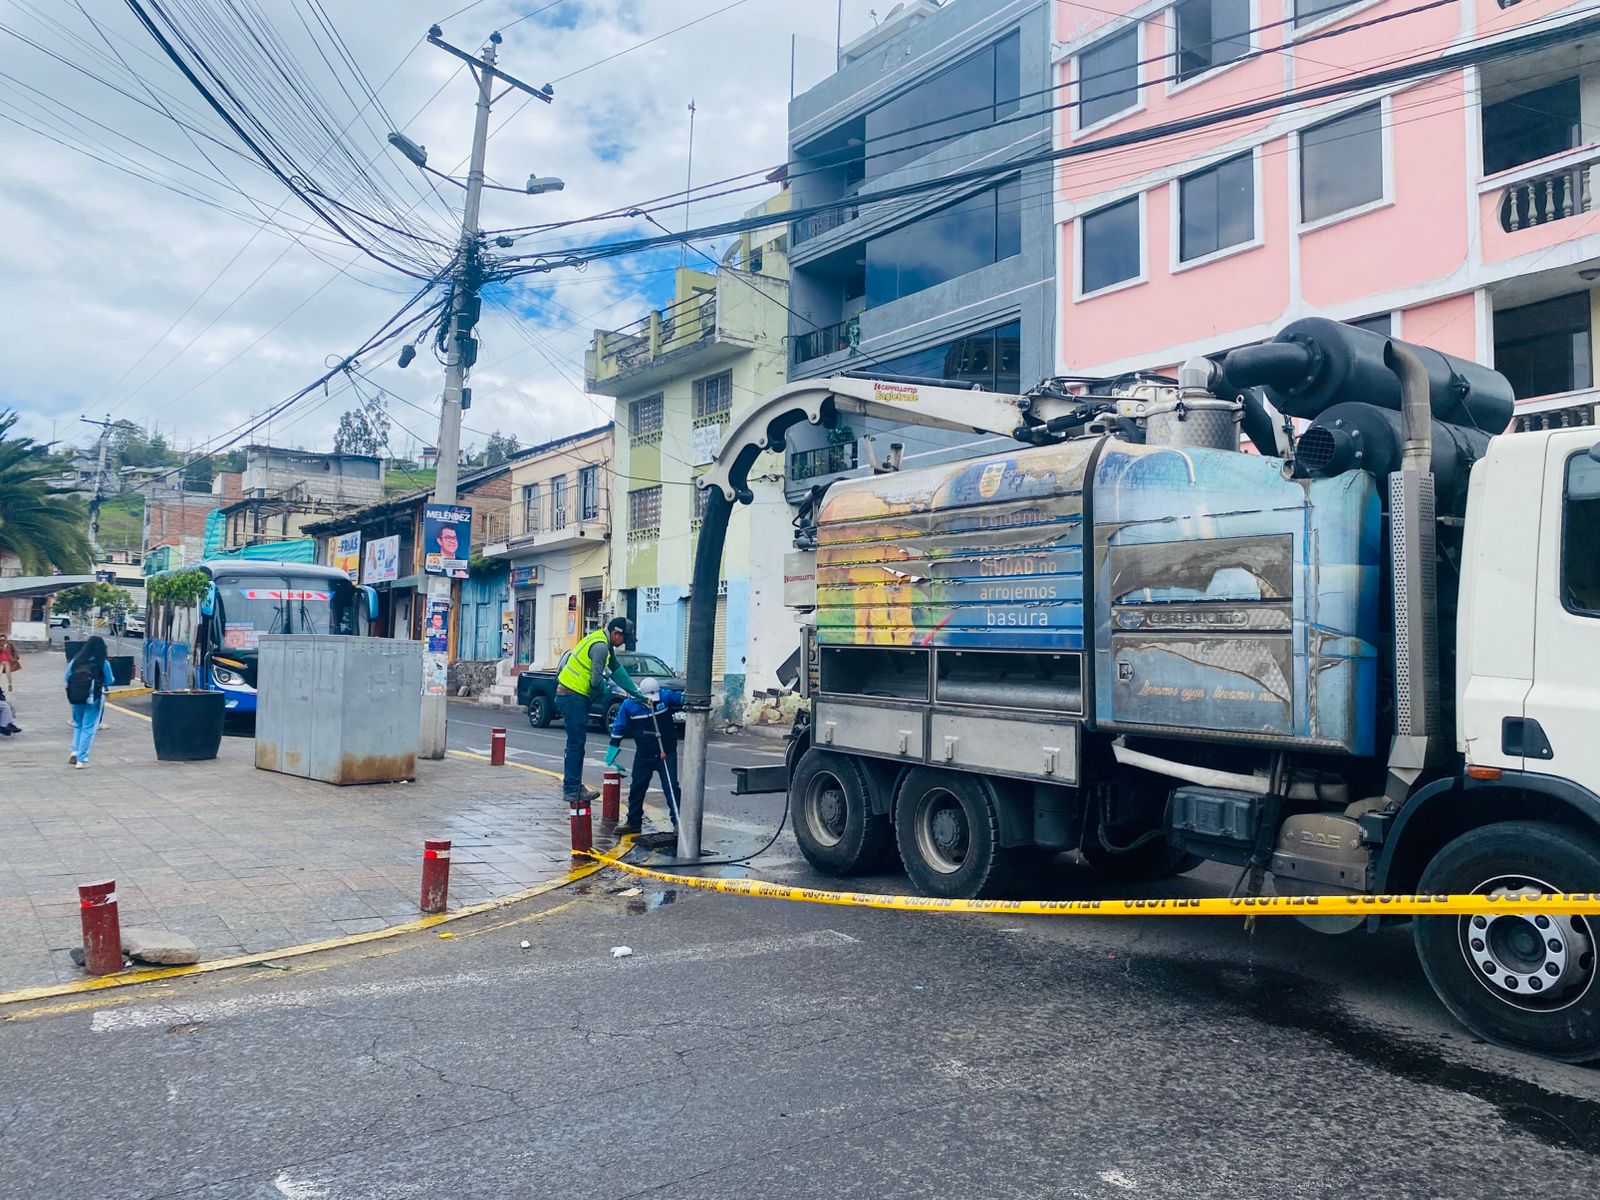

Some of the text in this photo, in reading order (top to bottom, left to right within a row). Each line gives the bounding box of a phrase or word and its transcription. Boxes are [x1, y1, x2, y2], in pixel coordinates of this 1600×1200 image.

[979, 557, 1057, 577] CIUDAD no
[979, 585, 1057, 603] arrojemos
[986, 607, 1049, 627] basura
[1151, 612, 1243, 624] CAPPELLOTTO
